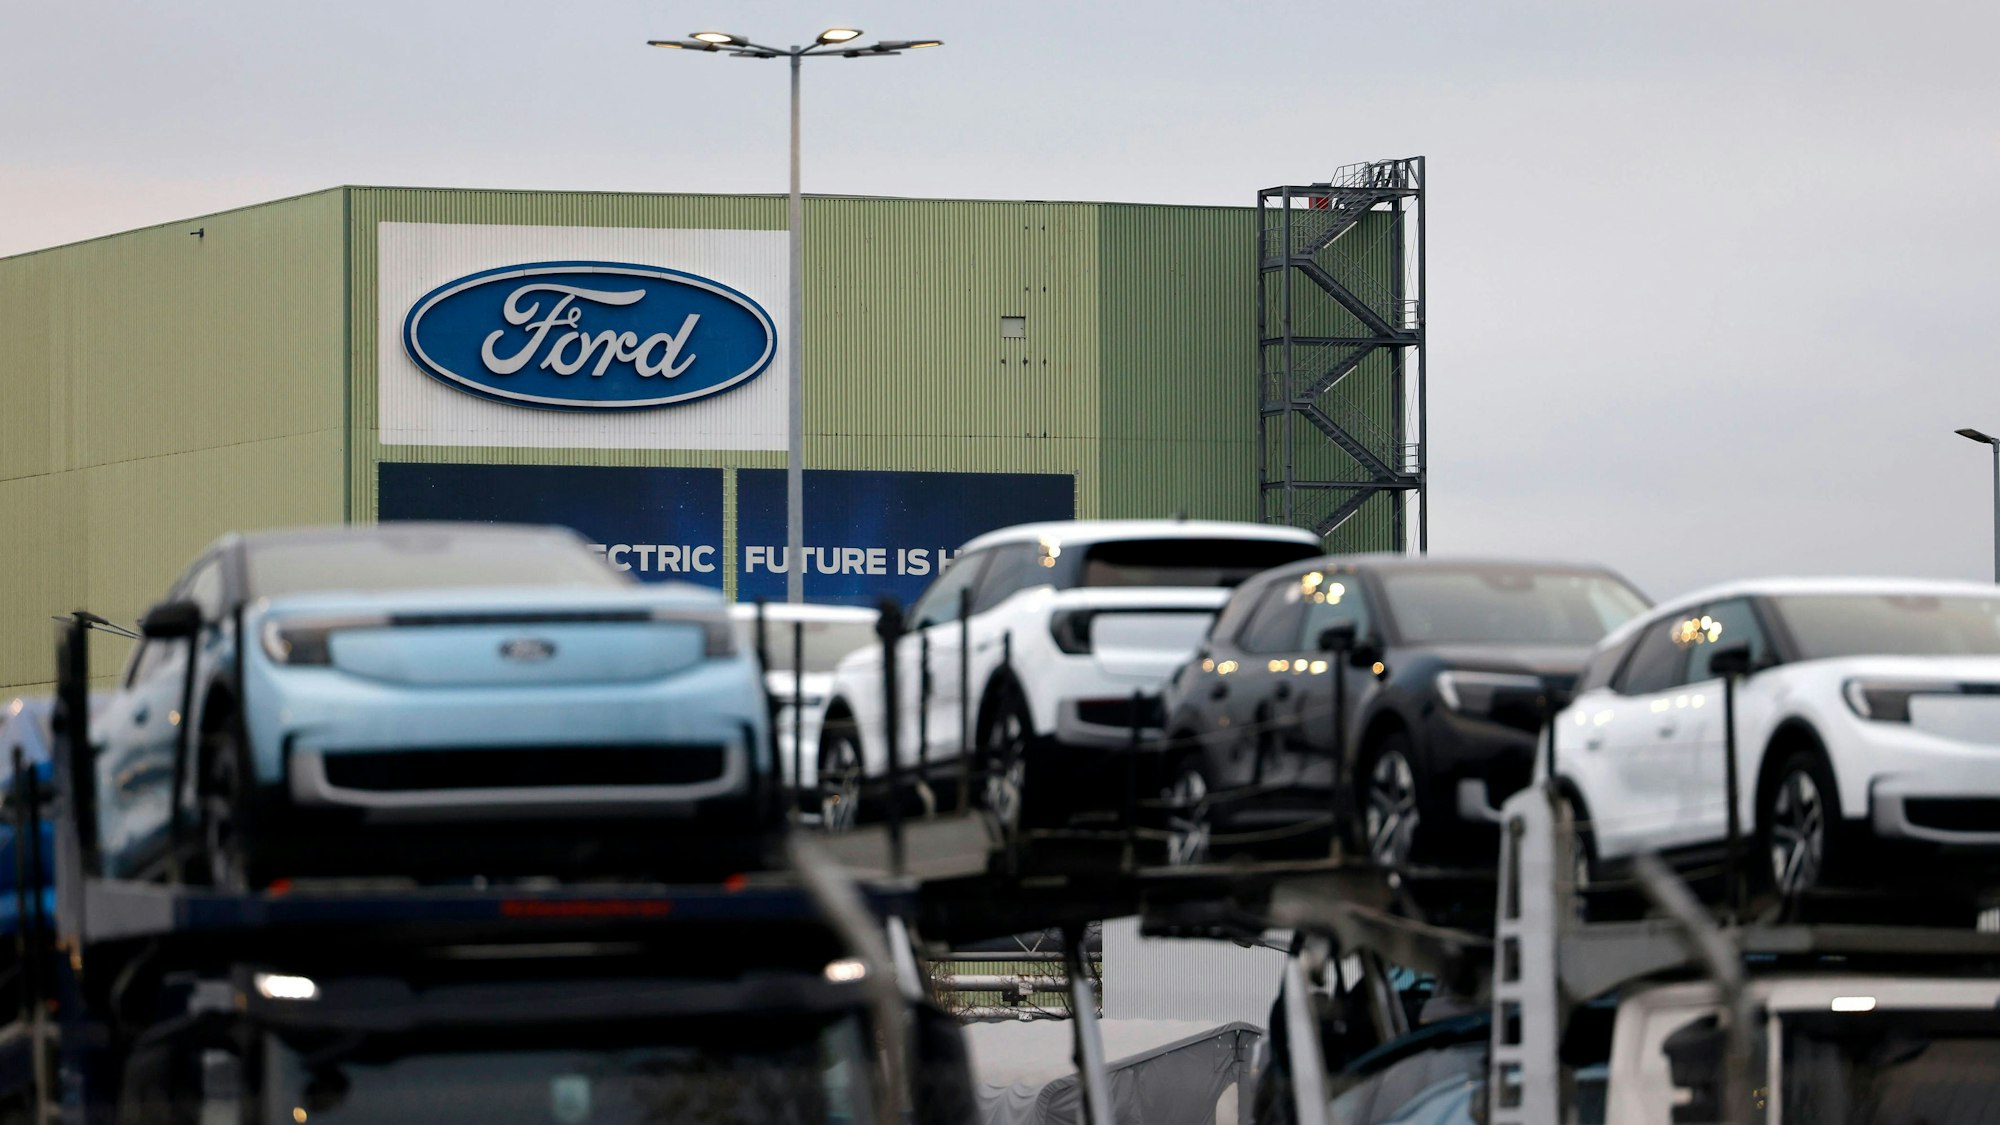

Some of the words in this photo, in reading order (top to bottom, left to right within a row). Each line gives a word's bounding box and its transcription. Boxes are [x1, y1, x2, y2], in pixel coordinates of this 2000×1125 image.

[481, 283, 701, 379] Ford
[745, 546, 887, 575] FUTURE
[897, 548, 931, 576] IS
